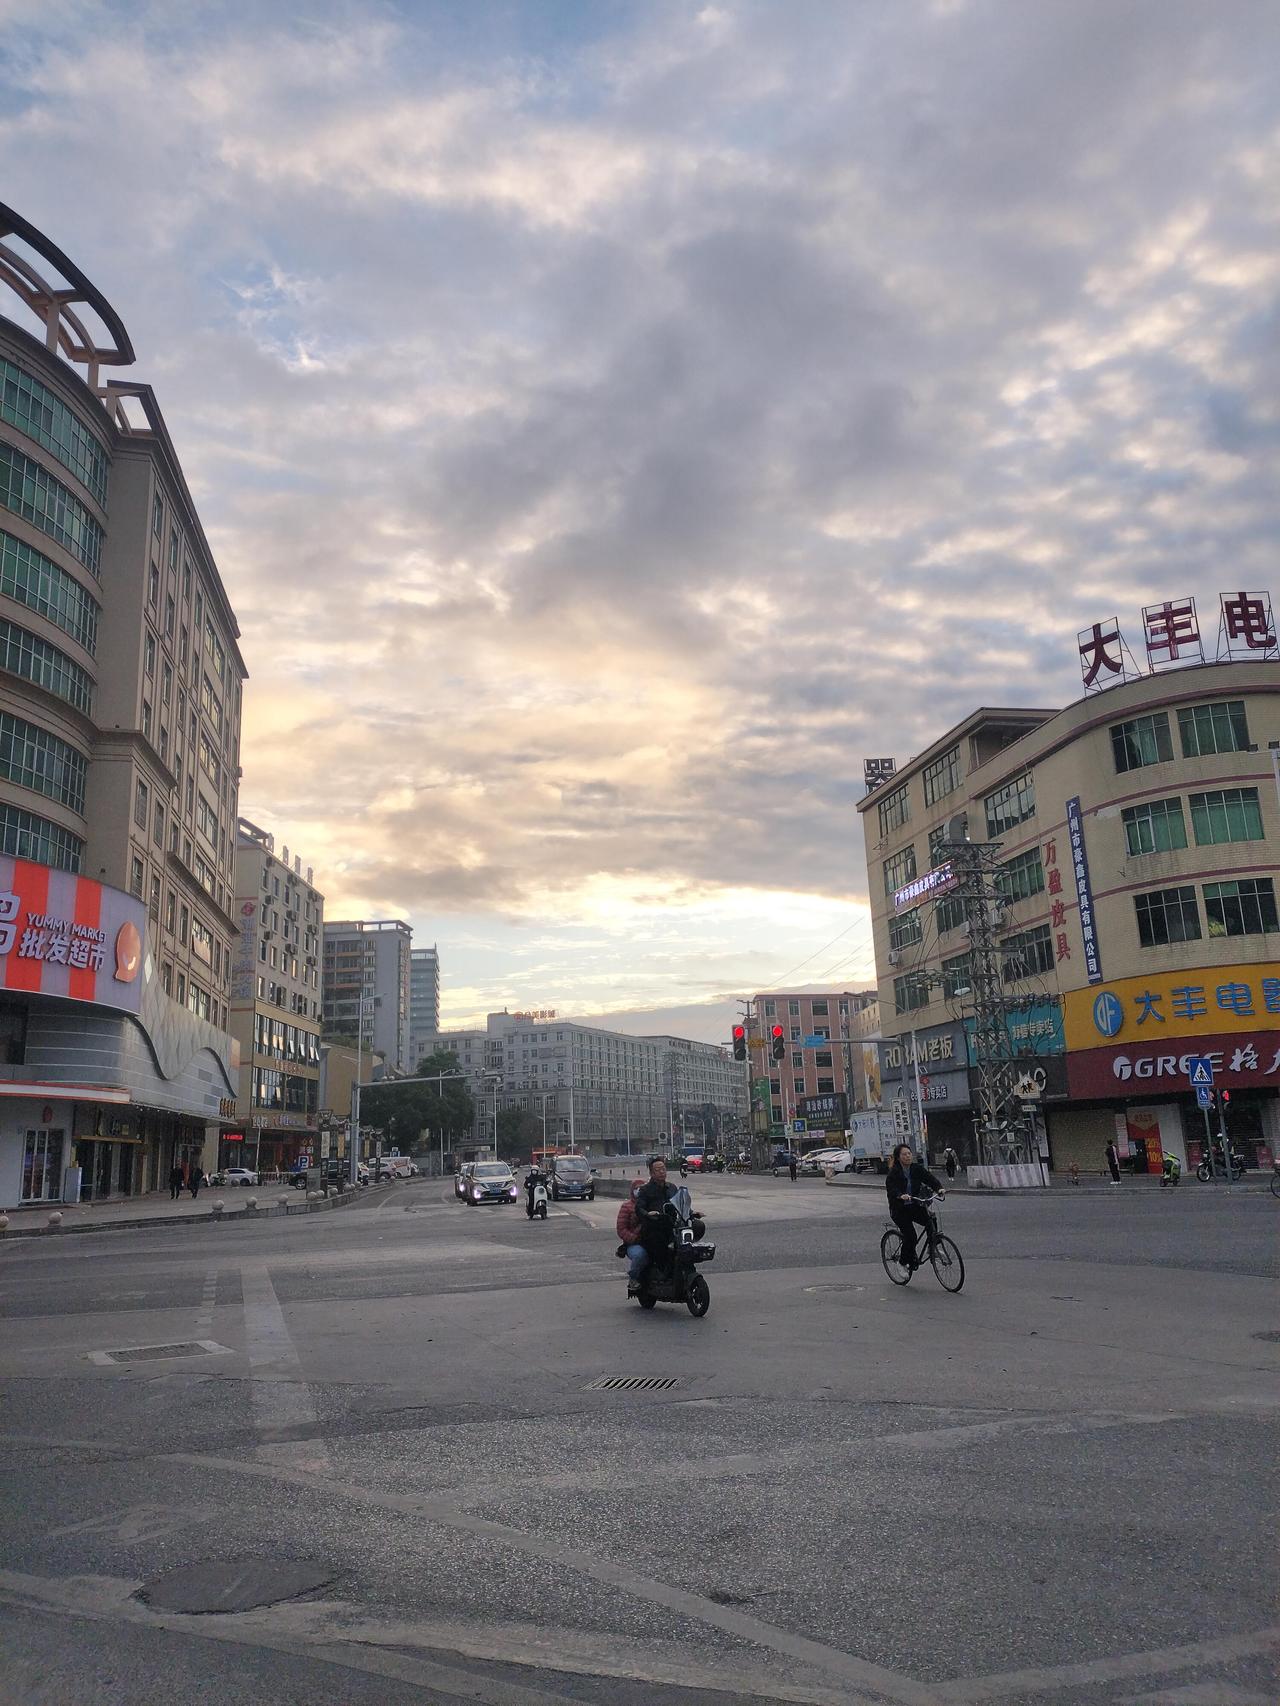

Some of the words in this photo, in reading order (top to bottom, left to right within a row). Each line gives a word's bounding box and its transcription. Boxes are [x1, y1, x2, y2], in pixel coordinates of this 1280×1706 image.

[27, 912, 69, 933] YUMMY
[19, 929, 107, 971] 批发超市
